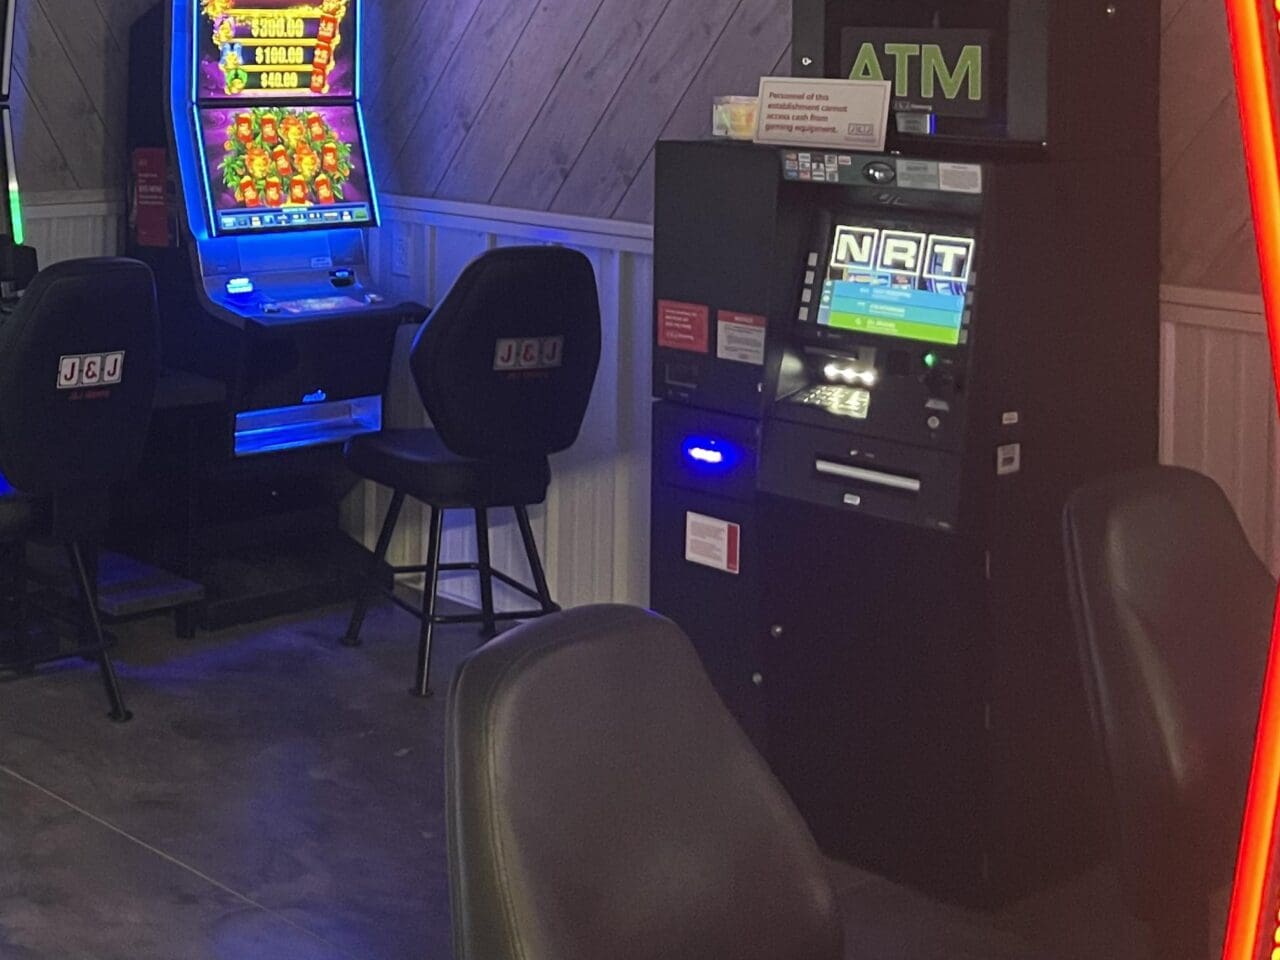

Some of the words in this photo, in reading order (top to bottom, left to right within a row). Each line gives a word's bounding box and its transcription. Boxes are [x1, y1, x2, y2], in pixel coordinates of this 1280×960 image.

[848, 42, 982, 100] ATM
[767, 102, 819, 111] establishment
[821, 105, 848, 113] cannot
[769, 92, 805, 100] Personnel
[834, 230, 970, 277] NRT
[497, 339, 559, 366] J&J
[62, 355, 121, 383] J&J
